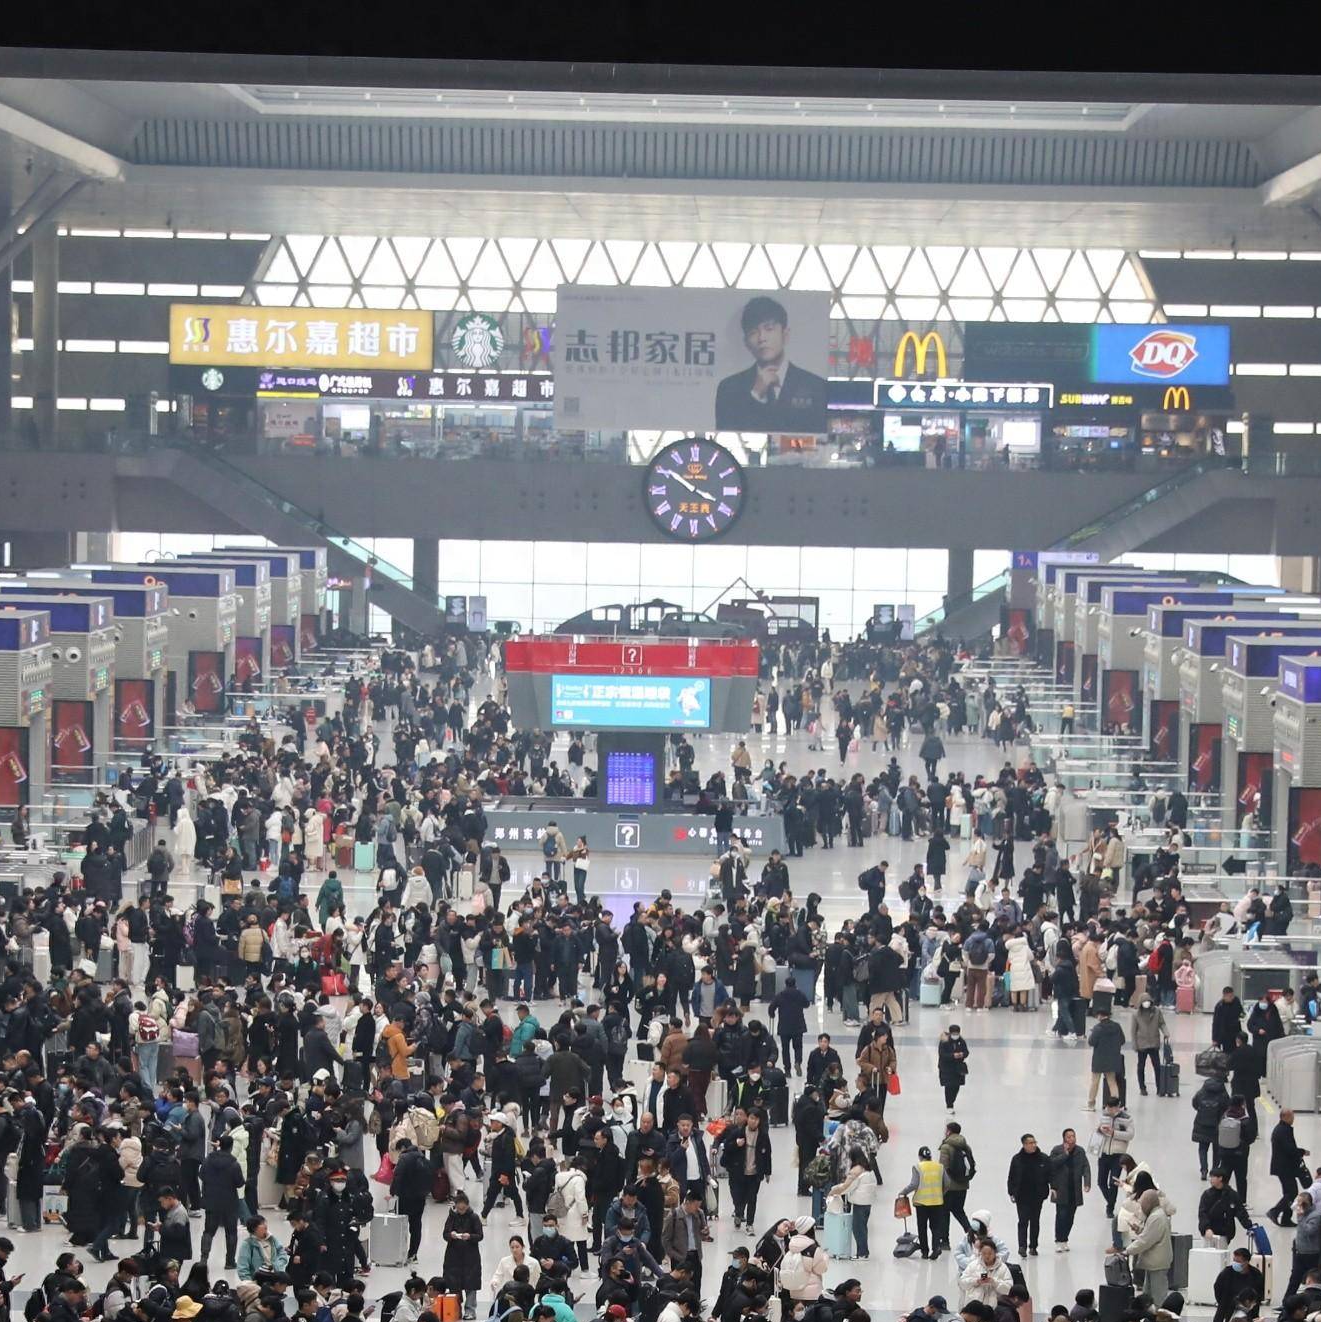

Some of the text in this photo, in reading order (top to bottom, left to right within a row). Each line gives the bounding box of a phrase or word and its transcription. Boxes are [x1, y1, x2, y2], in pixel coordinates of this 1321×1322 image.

[226, 318, 420, 358] 惠尔嘉超市
[565, 330, 716, 367] 志邦家居
[1142, 339, 1186, 366] DQ
[428, 376, 554, 398] 惠尔嘉超市
[1060, 394, 1110, 406] SUBWAY
